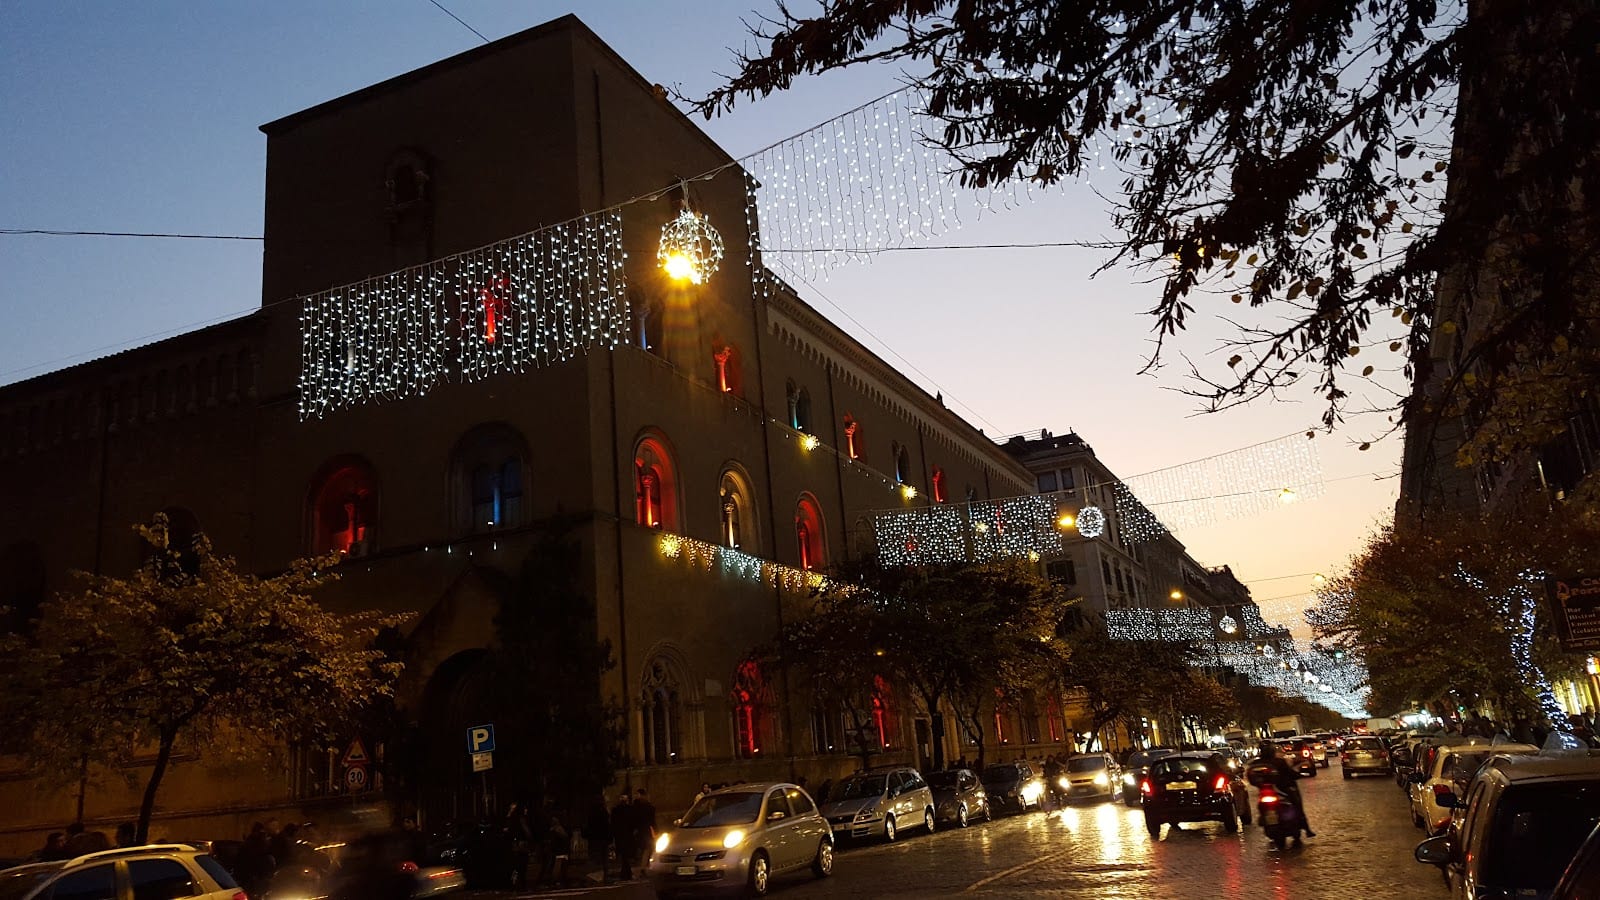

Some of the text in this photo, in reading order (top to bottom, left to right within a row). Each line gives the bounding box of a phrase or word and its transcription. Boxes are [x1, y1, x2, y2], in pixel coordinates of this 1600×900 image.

[1580, 578, 1600, 587] Ca
[472, 728, 489, 751] P
[350, 771, 363, 783] 30
